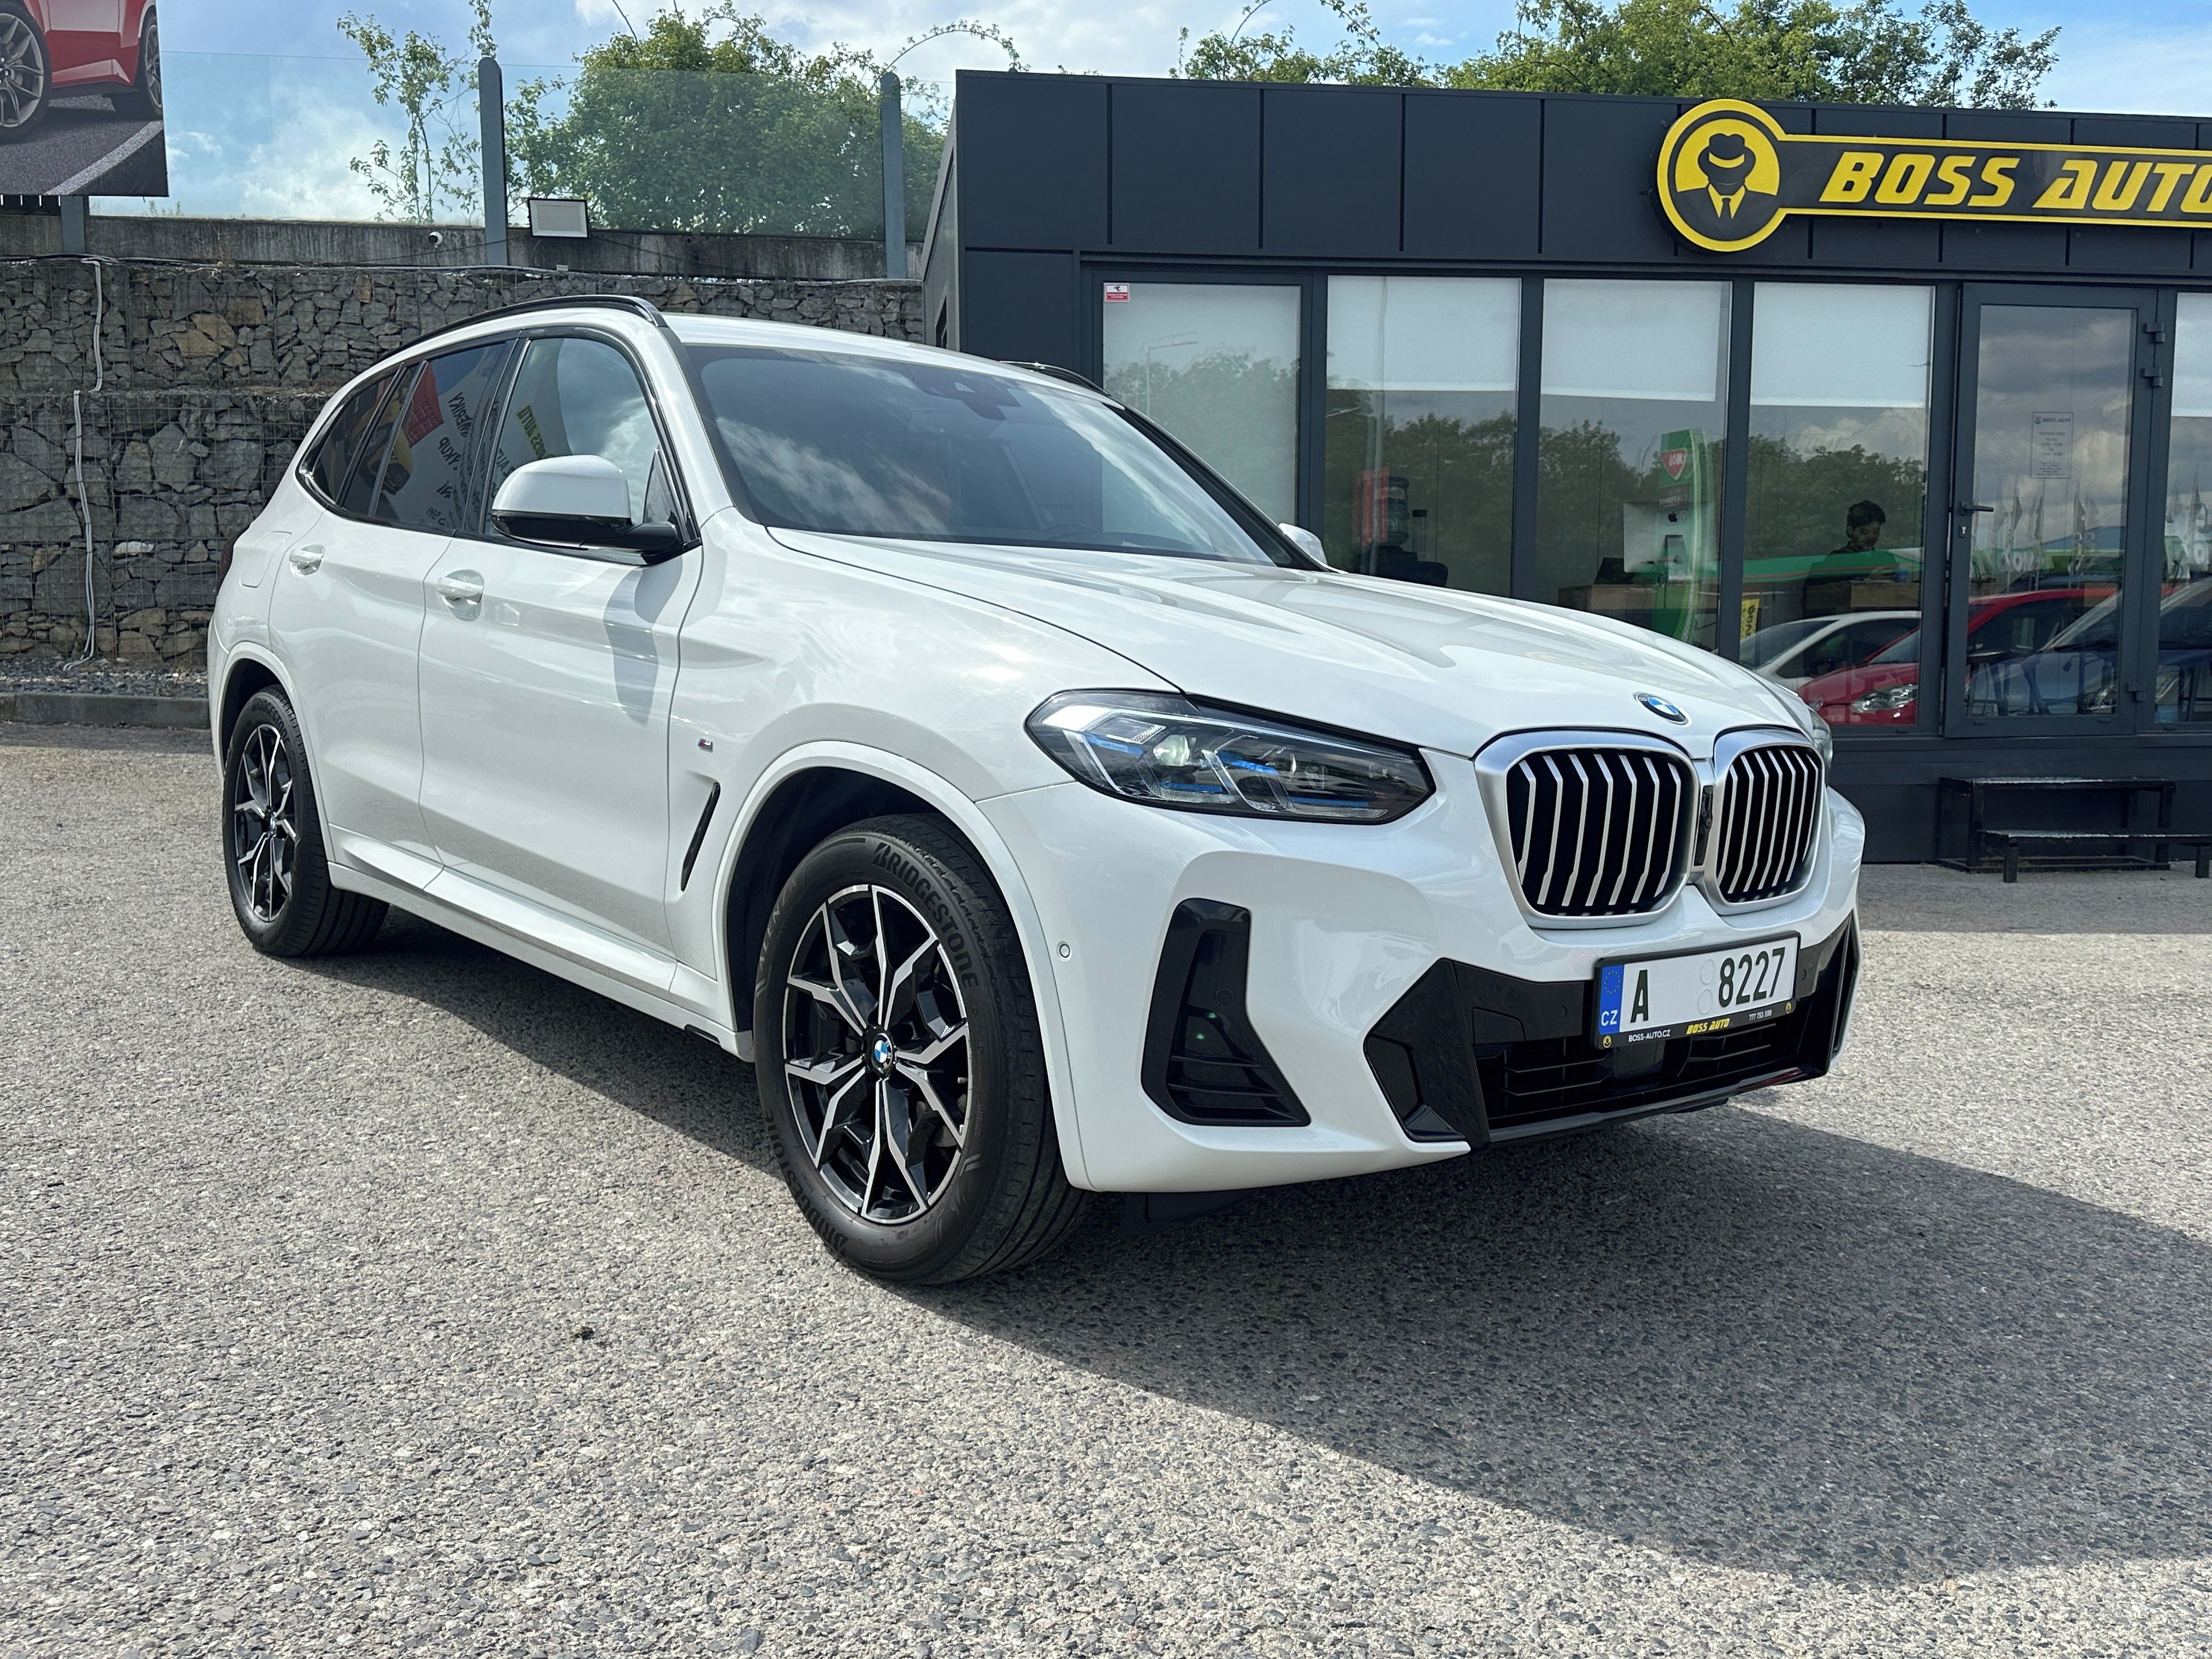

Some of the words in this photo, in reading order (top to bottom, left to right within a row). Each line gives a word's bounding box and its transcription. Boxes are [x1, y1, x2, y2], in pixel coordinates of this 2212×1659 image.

[1820, 151, 2020, 207] BOSS
[2033, 160, 2212, 213] AUTO
[872, 843, 979, 989] BRIDGESTONE
[1630, 969, 1649, 1023] A
[1718, 947, 1786, 1008] 8227
[1600, 1009, 1618, 1026] CZ
[1628, 1029, 1671, 1042] BOSS-AUTO.CZ
[1686, 1022, 1707, 1035] BOSS
[1708, 1018, 1730, 1031] AUTO
